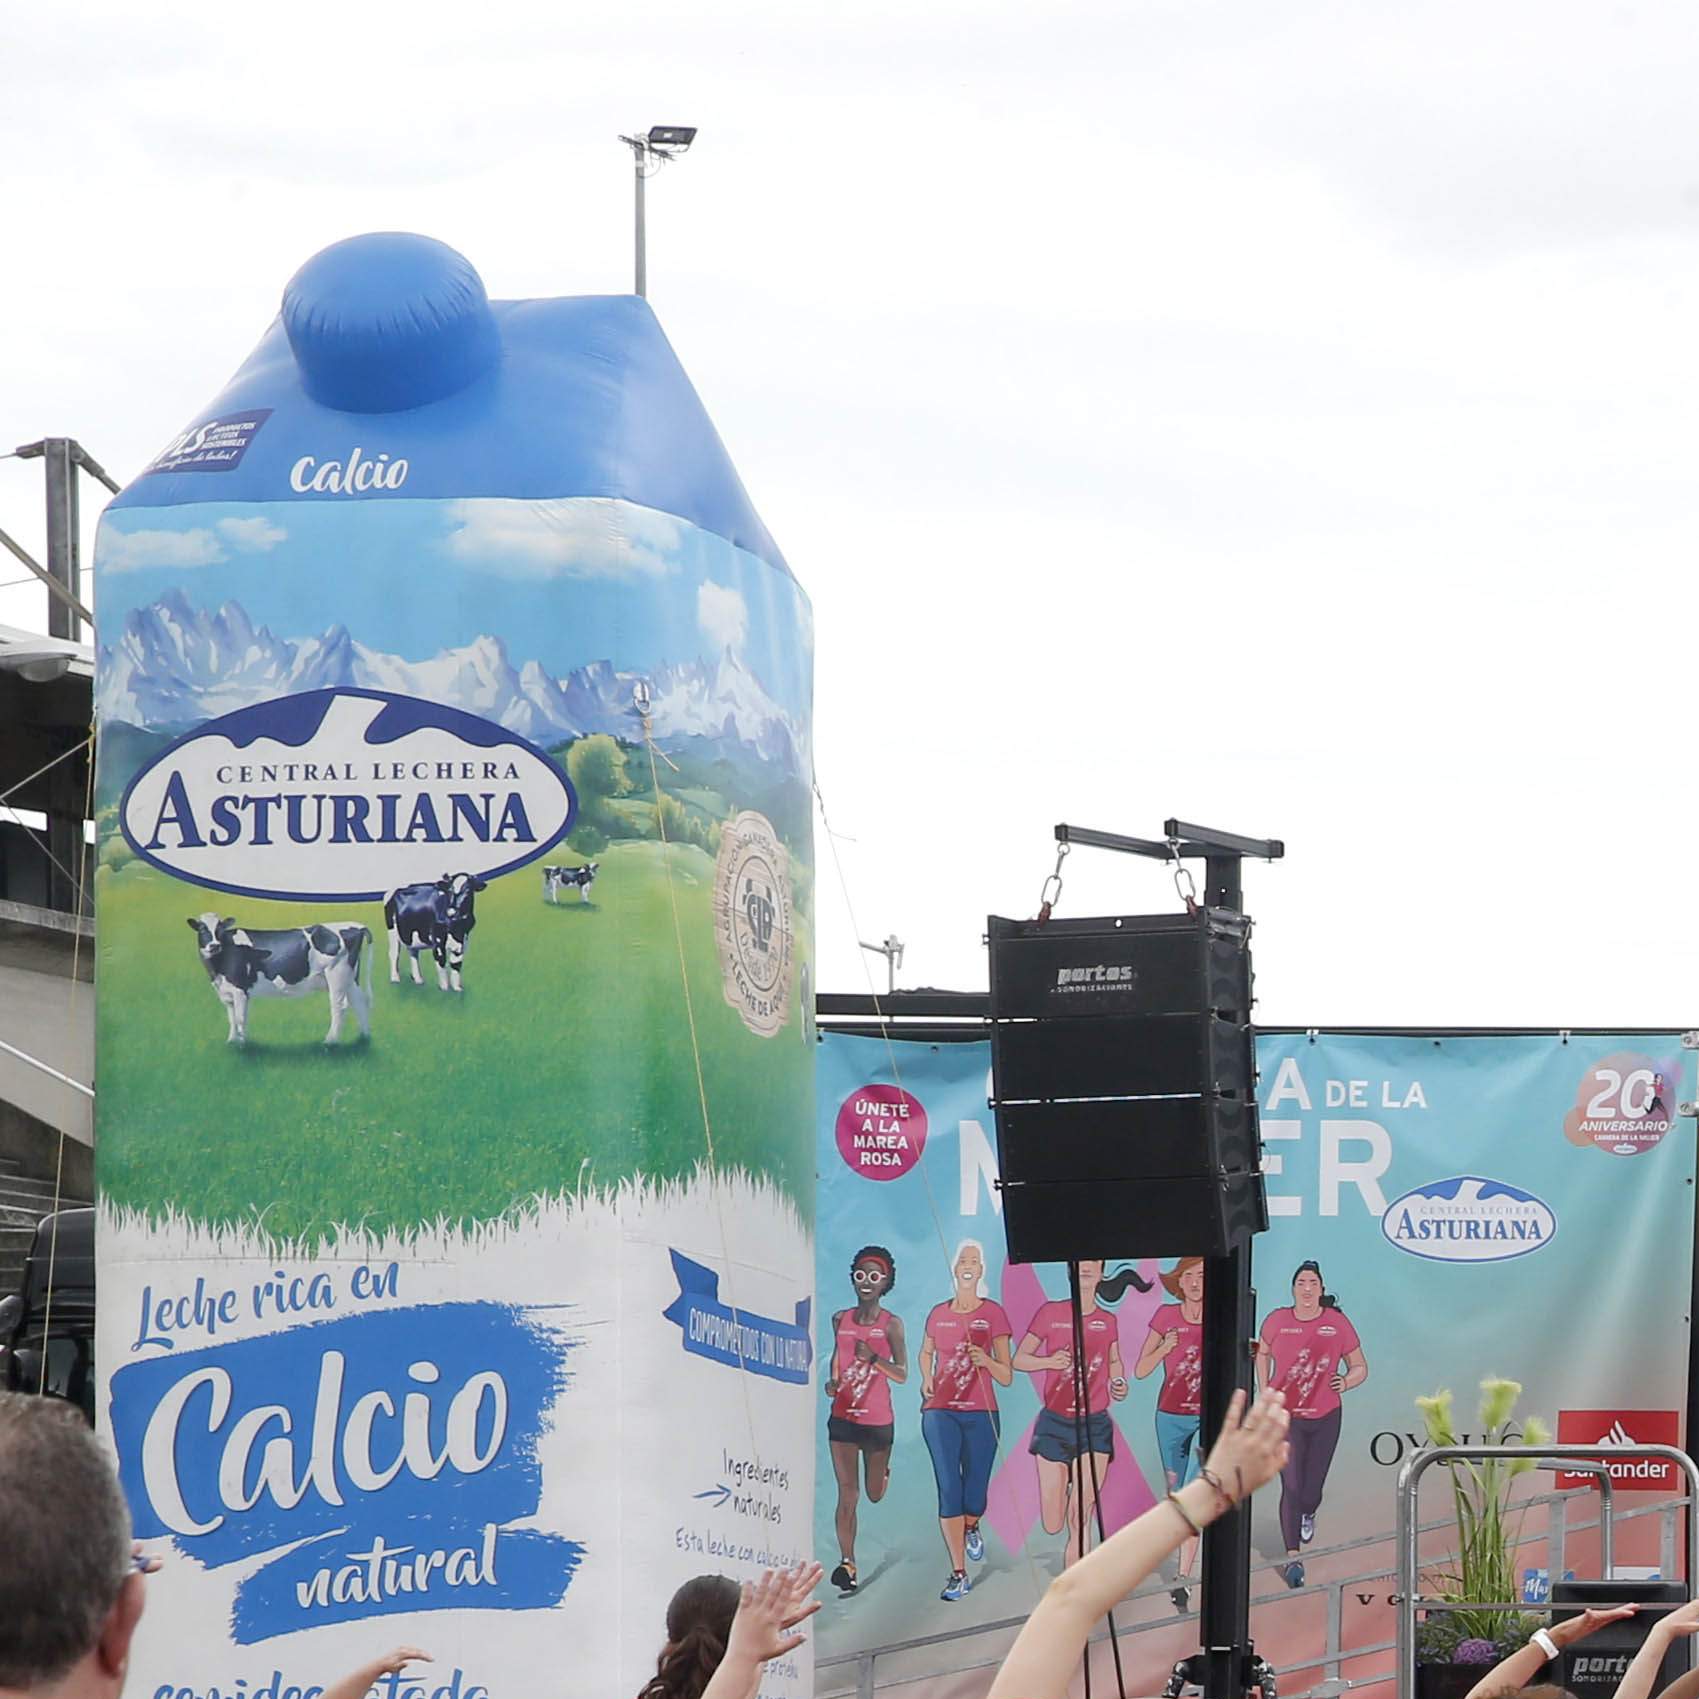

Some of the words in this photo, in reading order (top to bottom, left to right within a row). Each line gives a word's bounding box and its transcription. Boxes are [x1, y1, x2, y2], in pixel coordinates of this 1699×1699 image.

[216, 763, 358, 781] CENTRAL
[371, 761, 522, 780] LECHERA
[144, 769, 539, 850] ASTURIANA
[855, 1098, 910, 1118] ÚNETE
[1325, 1080, 1371, 1108] DE
[1380, 1080, 1429, 1110] LA
[862, 1118, 873, 1132] A
[878, 1119, 901, 1133] LA
[1578, 1120, 1668, 1132] ANIVERSARIO
[853, 1135, 909, 1149] MAREA
[860, 1151, 902, 1166] ROSA
[1394, 1208, 1544, 1245] ASTURIANA
[129, 1283, 240, 1353] Leche
[251, 1266, 336, 1321] rica
[350, 1260, 400, 1300] en
[141, 1350, 509, 1537] Calcio
[722, 1448, 790, 1491] Ingredientes
[733, 1491, 783, 1525] naturales
[675, 1527, 705, 1552] Esta
[706, 1529, 738, 1559] leche
[296, 1523, 498, 1610] natural
